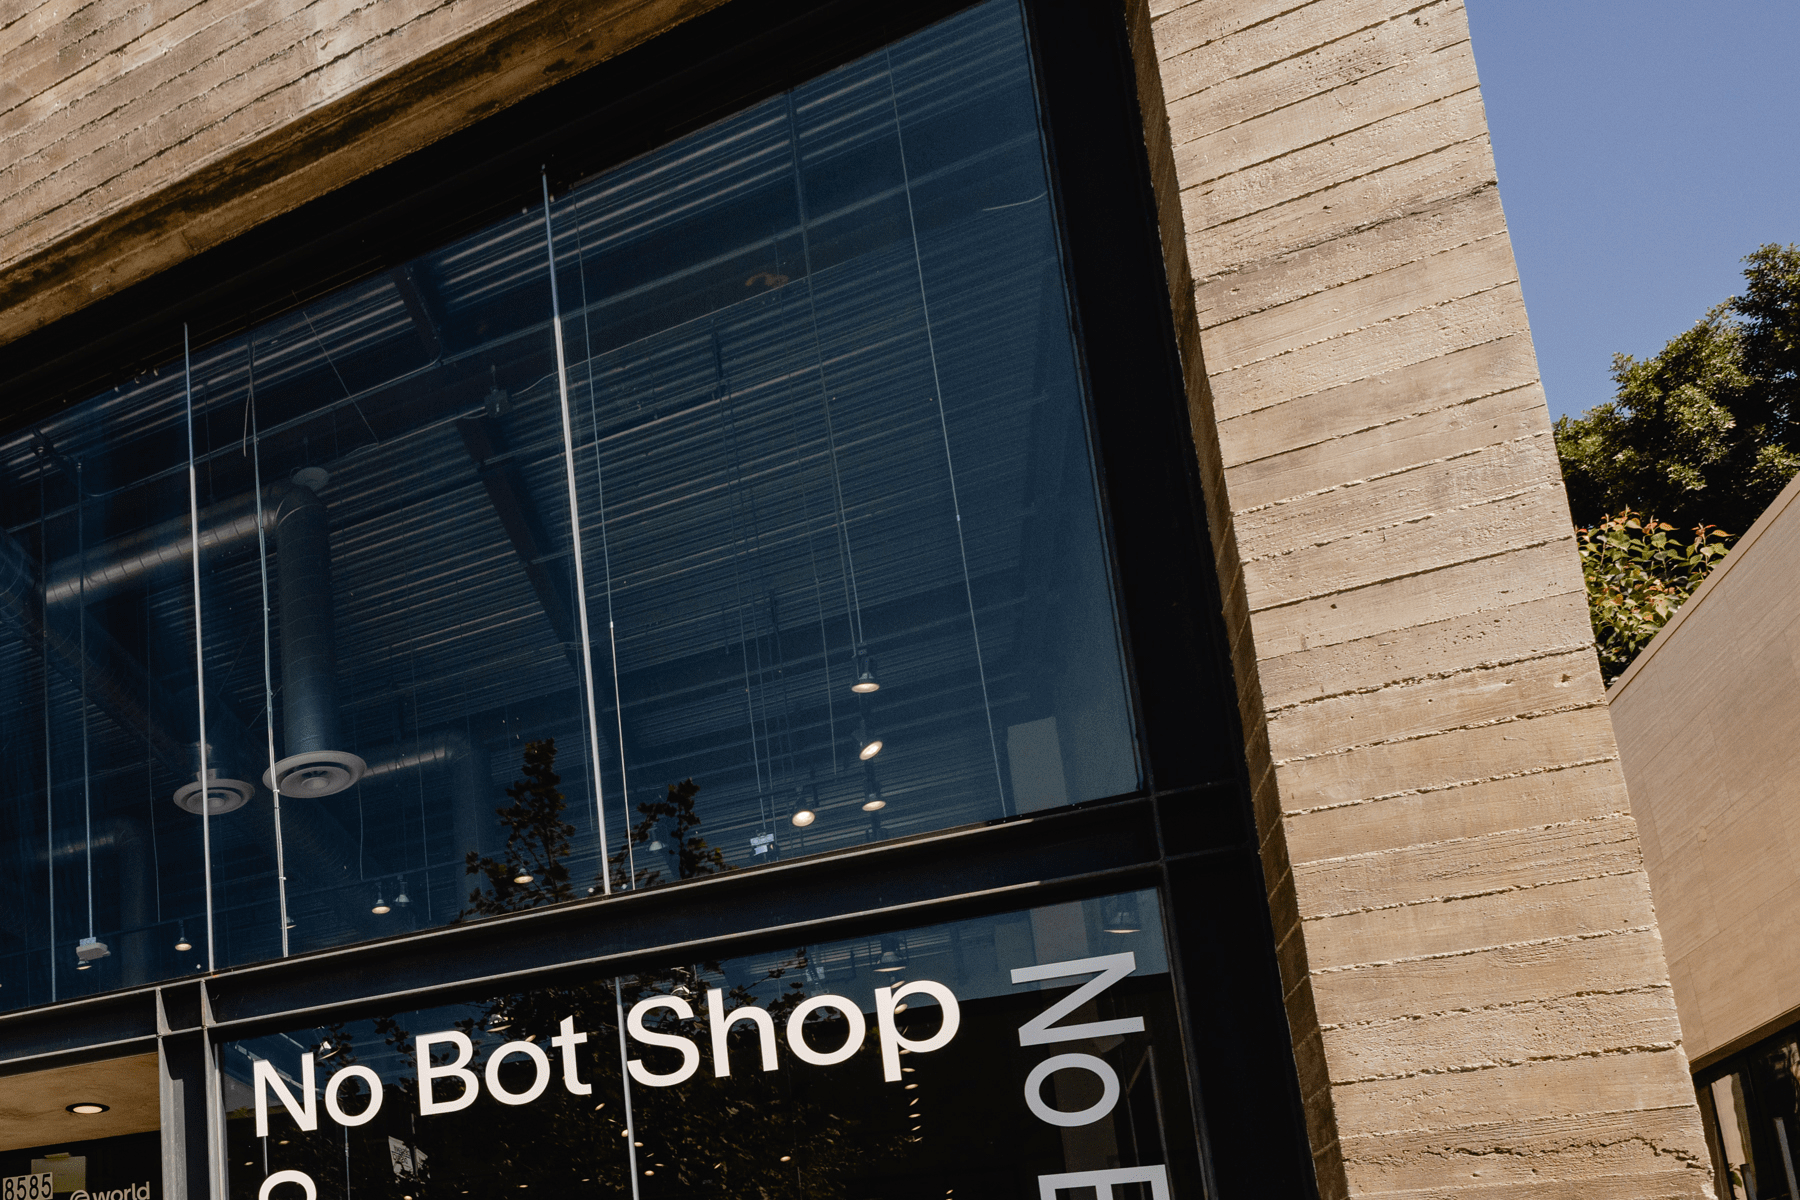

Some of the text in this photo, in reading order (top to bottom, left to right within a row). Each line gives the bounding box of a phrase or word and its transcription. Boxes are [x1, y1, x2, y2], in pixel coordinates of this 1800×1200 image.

[253, 979, 961, 1138] No Bot Shop
[1010, 951, 1146, 1128] No
